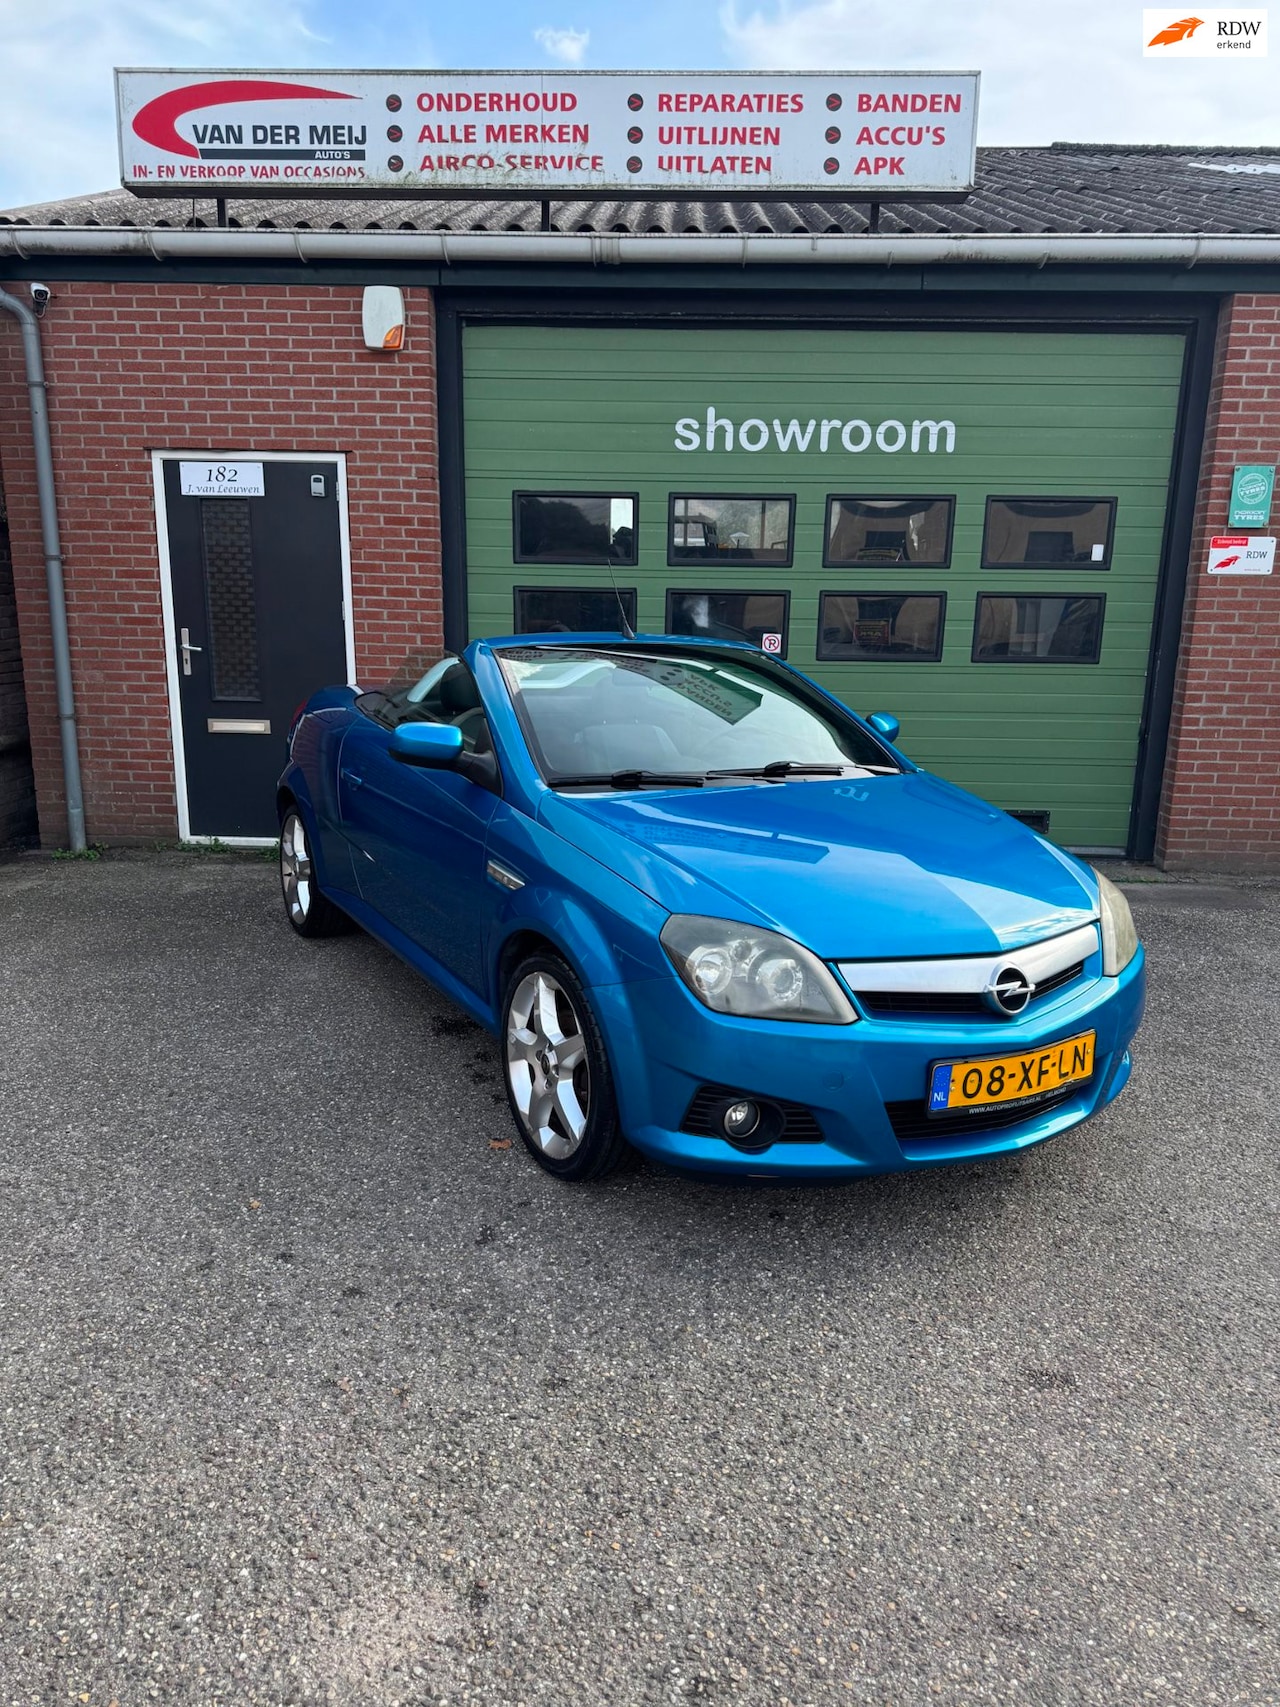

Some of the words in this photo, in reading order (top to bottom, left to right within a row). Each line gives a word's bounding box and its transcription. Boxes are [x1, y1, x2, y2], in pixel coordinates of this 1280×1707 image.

[417, 92, 578, 113] ONDERHOUD
[658, 93, 804, 113] REPARATIES
[857, 94, 962, 113] BANDEN
[192, 124, 243, 145] VAN
[252, 124, 300, 145] DER
[309, 125, 367, 146] MEIJ
[418, 124, 474, 143] ALLE
[485, 124, 589, 143] MERKEN
[658, 126, 780, 146] UITLIJNEN
[856, 126, 946, 146] ACCU'S
[315, 151, 351, 160] AUTO'S
[133, 165, 153, 177] IN-
[158, 165, 175, 178] EN
[180, 165, 246, 179] VERKOOP
[251, 165, 279, 178] VAN
[284, 166, 366, 179] OCCASIONS
[658, 156, 772, 175] UITLATEN
[854, 157, 905, 175] APK
[674, 406, 957, 453] showroom
[206, 465, 238, 482] 182
[186, 484, 194, 494] J.
[217, 484, 260, 494] Leeuwen
[1246, 550, 1268, 559] RDW
[962, 1042, 1087, 1099] 08-XF-LN
[933, 1091, 947, 1102] NL
